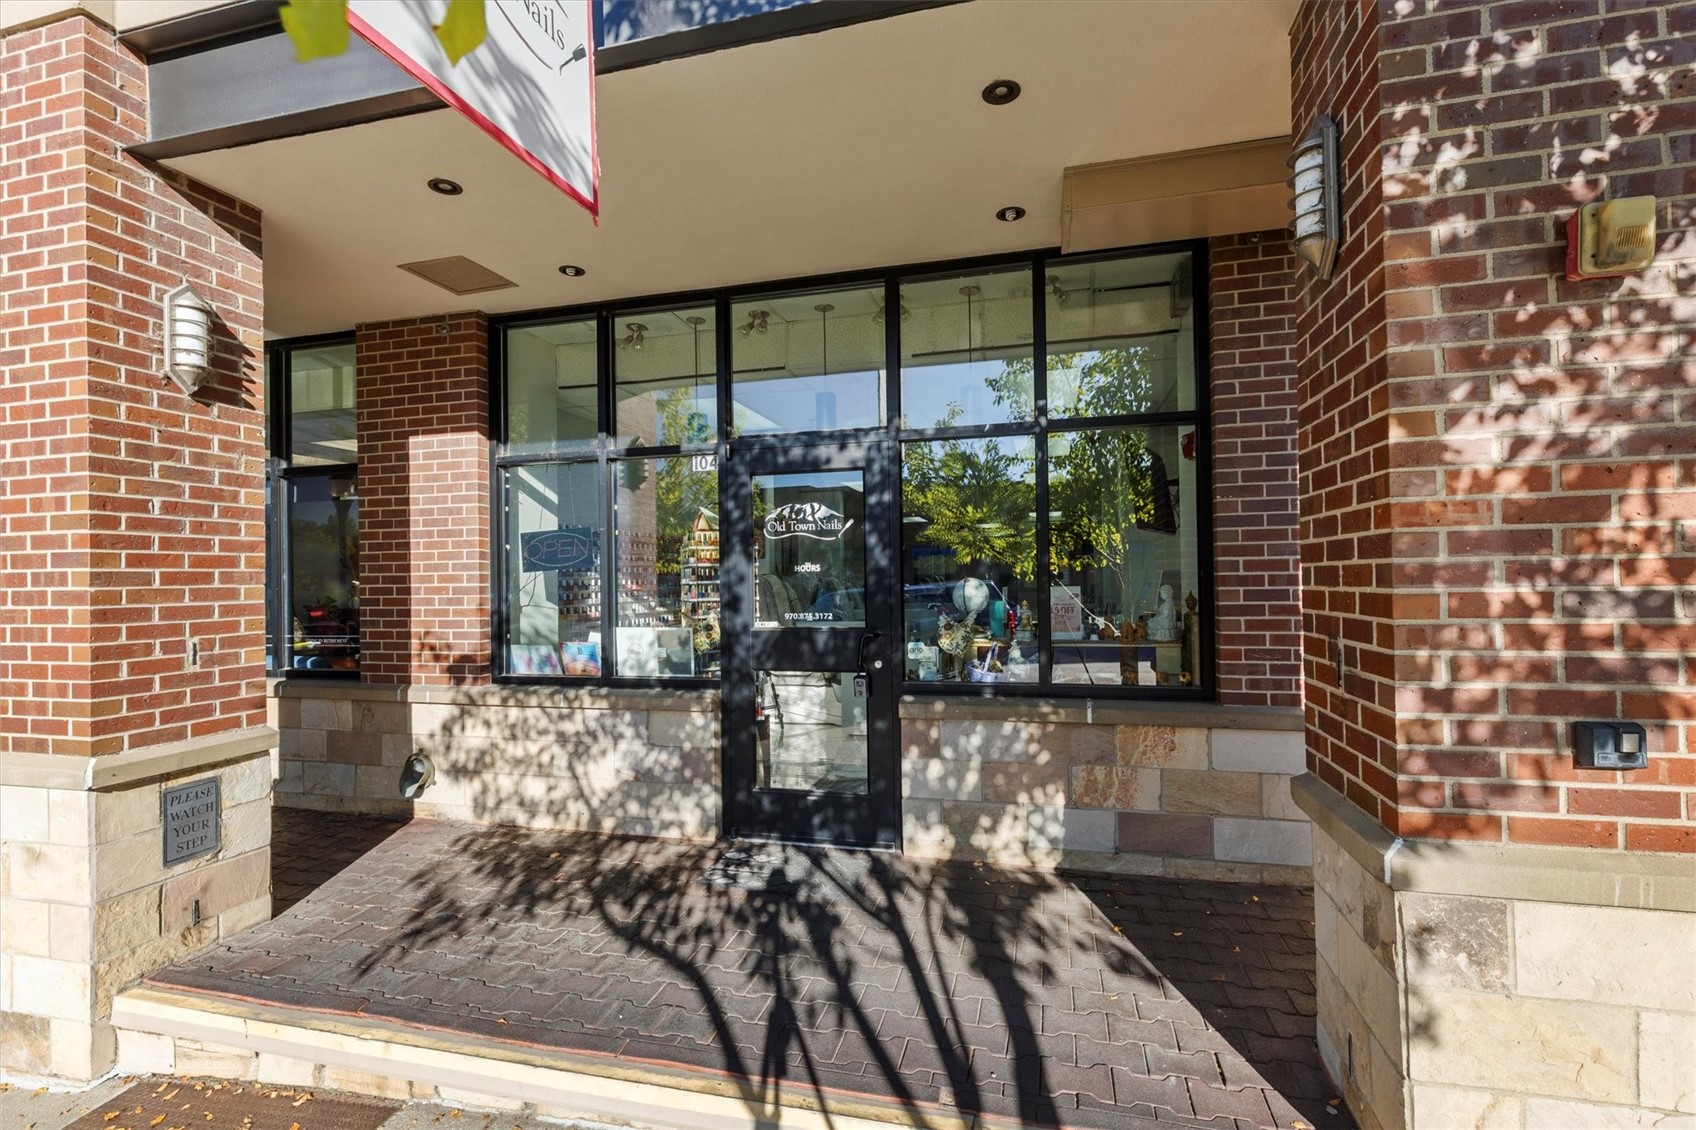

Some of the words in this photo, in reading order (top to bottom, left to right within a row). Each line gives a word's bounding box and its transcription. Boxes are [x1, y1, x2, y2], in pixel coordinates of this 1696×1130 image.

[516, 0, 565, 50] ails
[694, 455, 718, 470] 104
[767, 521, 786, 532] Old
[788, 521, 816, 532] Town
[817, 519, 843, 530] Nails
[525, 538, 590, 560] OPEN
[794, 563, 821, 572] HOURS
[170, 786, 213, 807] PLEASE
[170, 802, 214, 822] WATCH
[173, 819, 211, 838] YOUR
[176, 834, 208, 853] STEP
